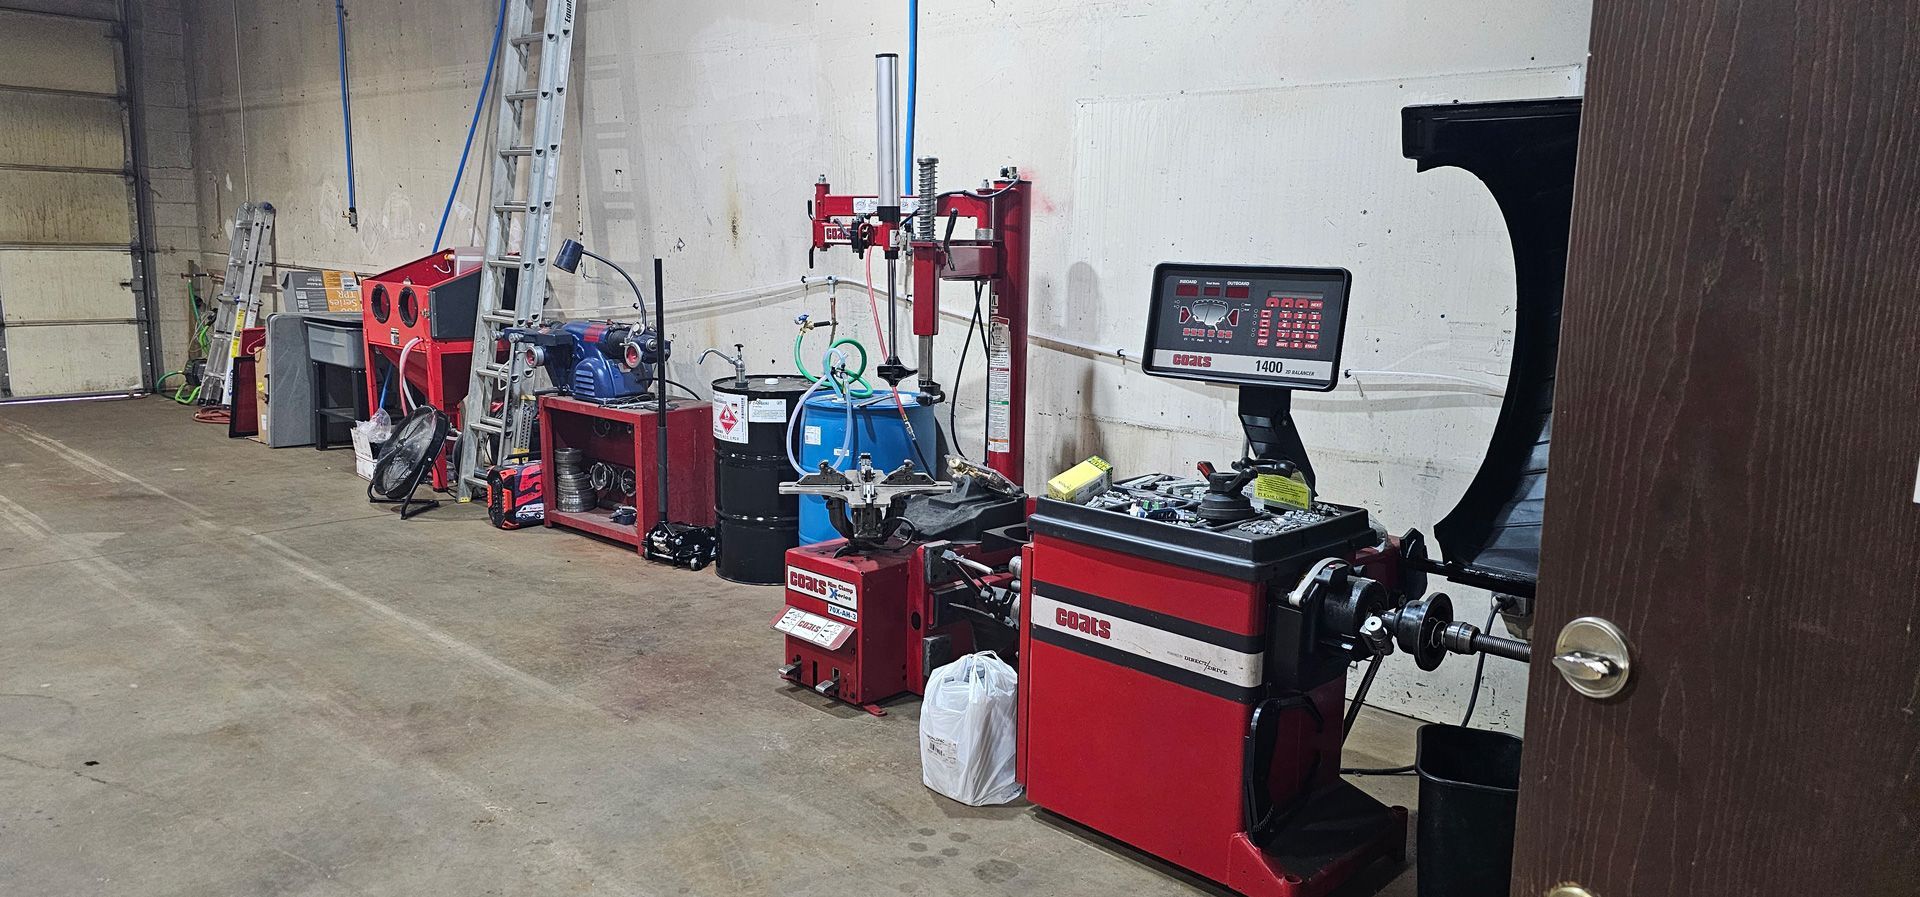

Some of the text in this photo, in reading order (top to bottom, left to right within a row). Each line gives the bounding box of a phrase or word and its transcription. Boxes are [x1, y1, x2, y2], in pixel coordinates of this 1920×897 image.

[826, 228, 850, 240] coa
[337, 290, 356, 298] TPR
[329, 298, 358, 307] Series
[1255, 359, 1283, 374] 1400
[838, 584, 854, 595] Clamp
[829, 605, 857, 620] 70X-AH-3
